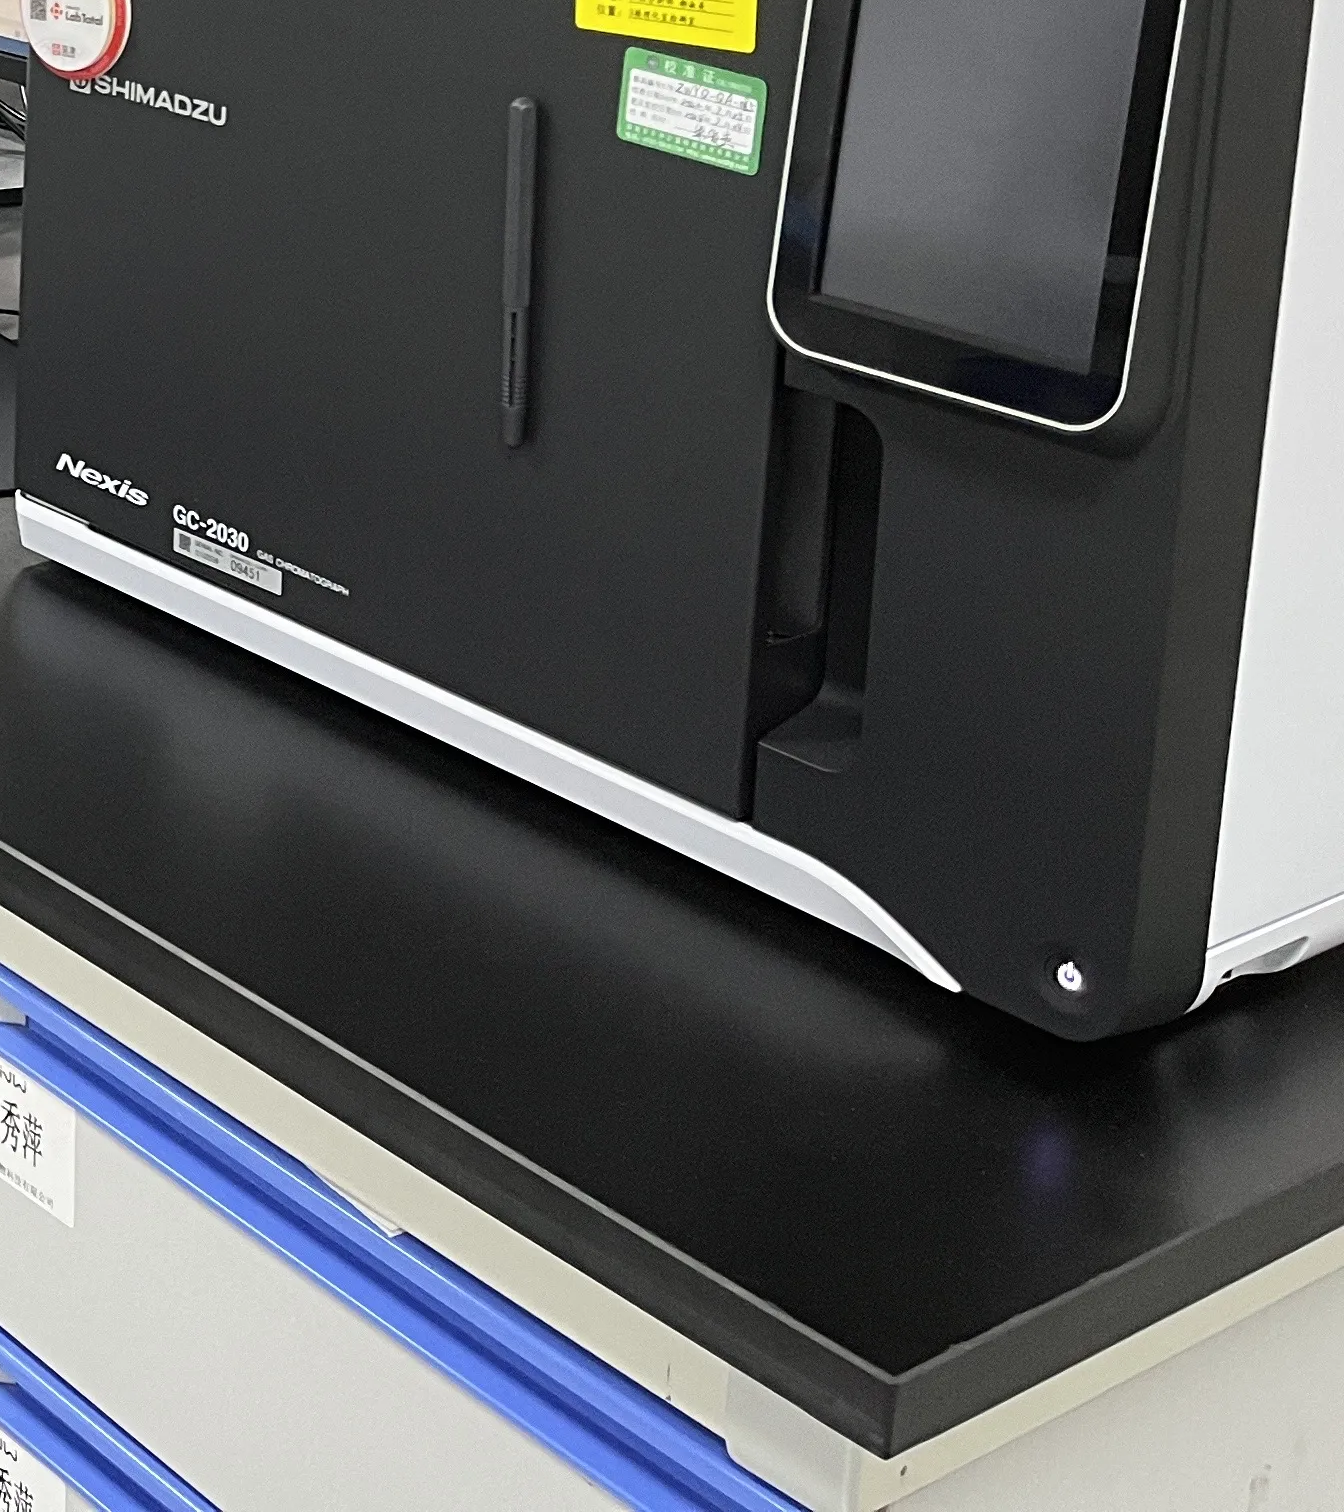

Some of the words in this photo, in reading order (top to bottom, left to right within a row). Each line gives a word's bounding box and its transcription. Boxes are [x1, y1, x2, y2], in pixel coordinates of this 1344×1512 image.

[94, 76, 229, 128] SHIMADZU
[55, 453, 150, 507] Nexis
[172, 504, 250, 553] GC-2030
